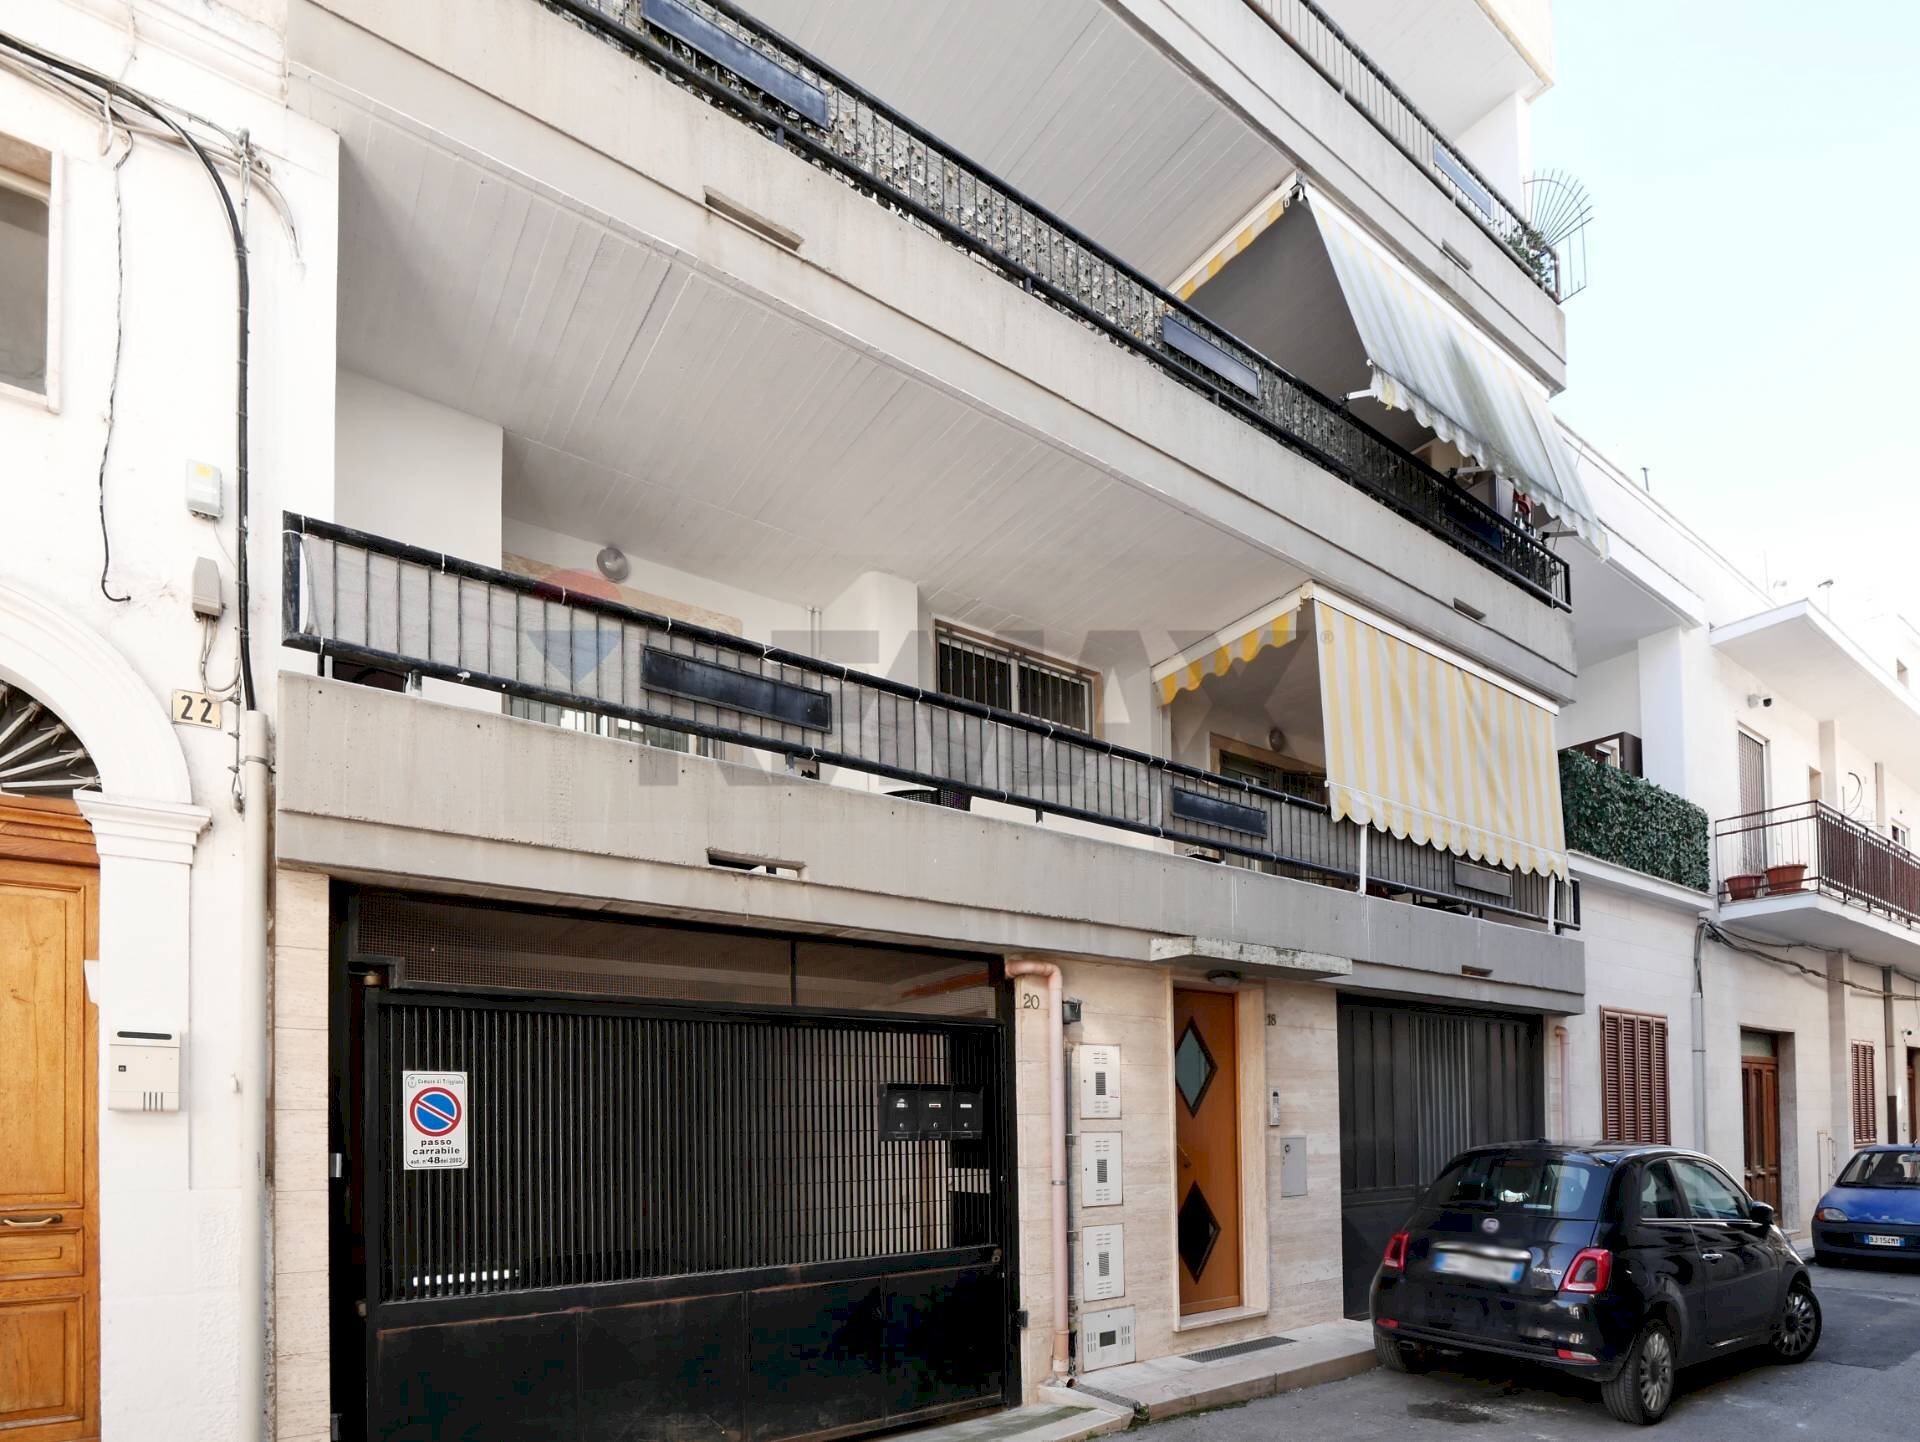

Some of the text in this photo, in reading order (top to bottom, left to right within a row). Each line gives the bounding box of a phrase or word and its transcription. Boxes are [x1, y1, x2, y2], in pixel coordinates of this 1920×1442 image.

[181, 694, 213, 724] 22
[1023, 992, 1040, 1010] 20
[1266, 1012, 1277, 1027] 18
[420, 1139, 452, 1147] passo
[412, 1146, 461, 1155] carrabile
[427, 1156, 440, 1164] 48
